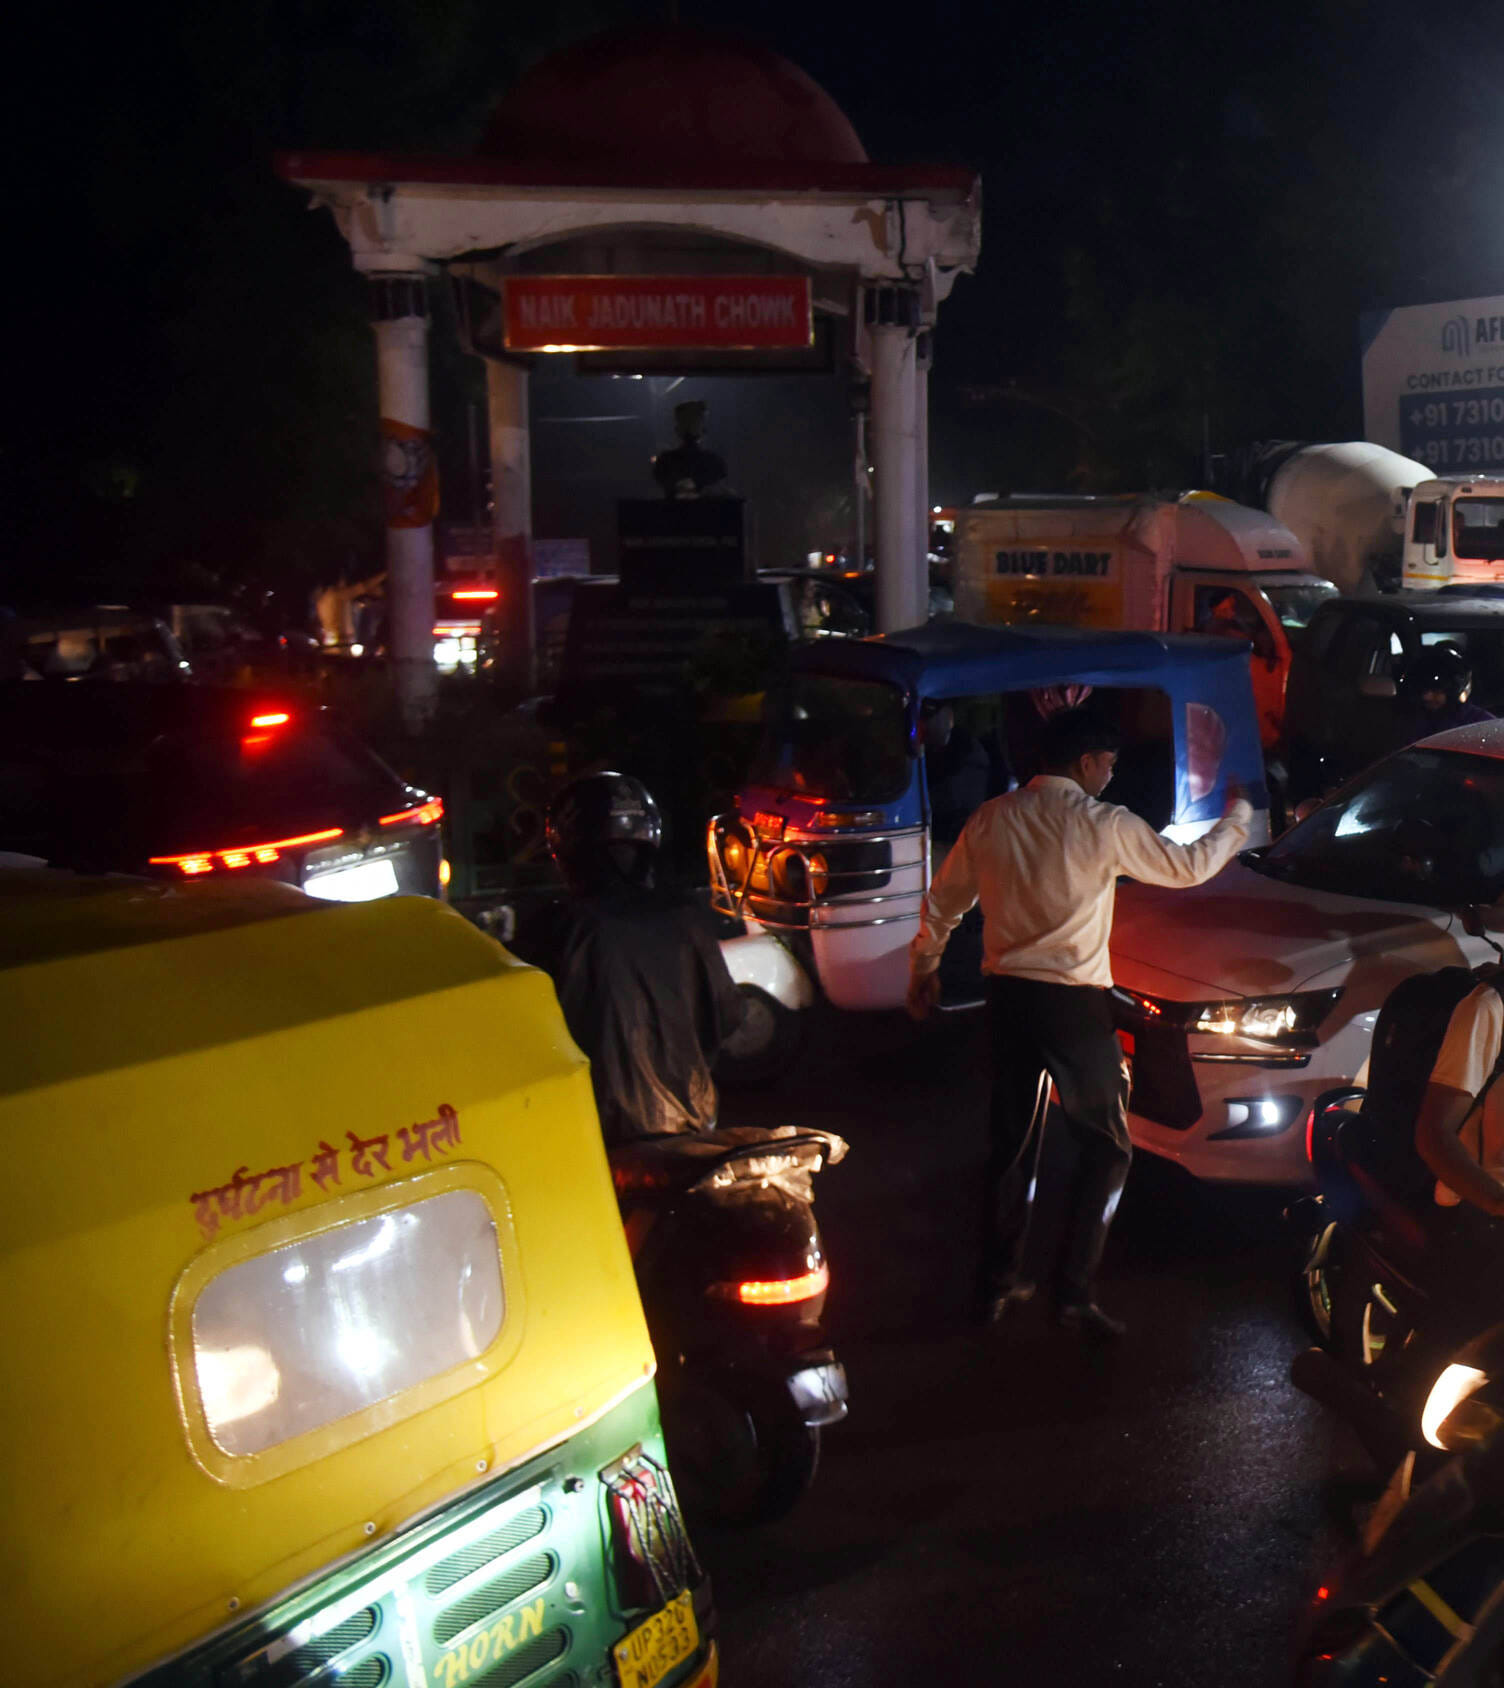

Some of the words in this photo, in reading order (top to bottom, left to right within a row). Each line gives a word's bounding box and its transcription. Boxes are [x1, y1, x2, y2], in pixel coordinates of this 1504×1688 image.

[520, 294, 576, 329] NAIK
[587, 294, 705, 329] JADUNATH
[715, 294, 797, 329] CHOWK
[1407, 368, 1484, 390] CONTACT
[1409, 402, 1449, 427] +91
[996, 551, 1047, 575] BLUE
[1053, 551, 1112, 576] DART
[190, 1162, 304, 1242] दुर्घटना
[310, 1140, 342, 1192] से
[346, 1130, 392, 1177] देर
[396, 1103, 463, 1163] भली
[433, 1597, 545, 1688] HORN
